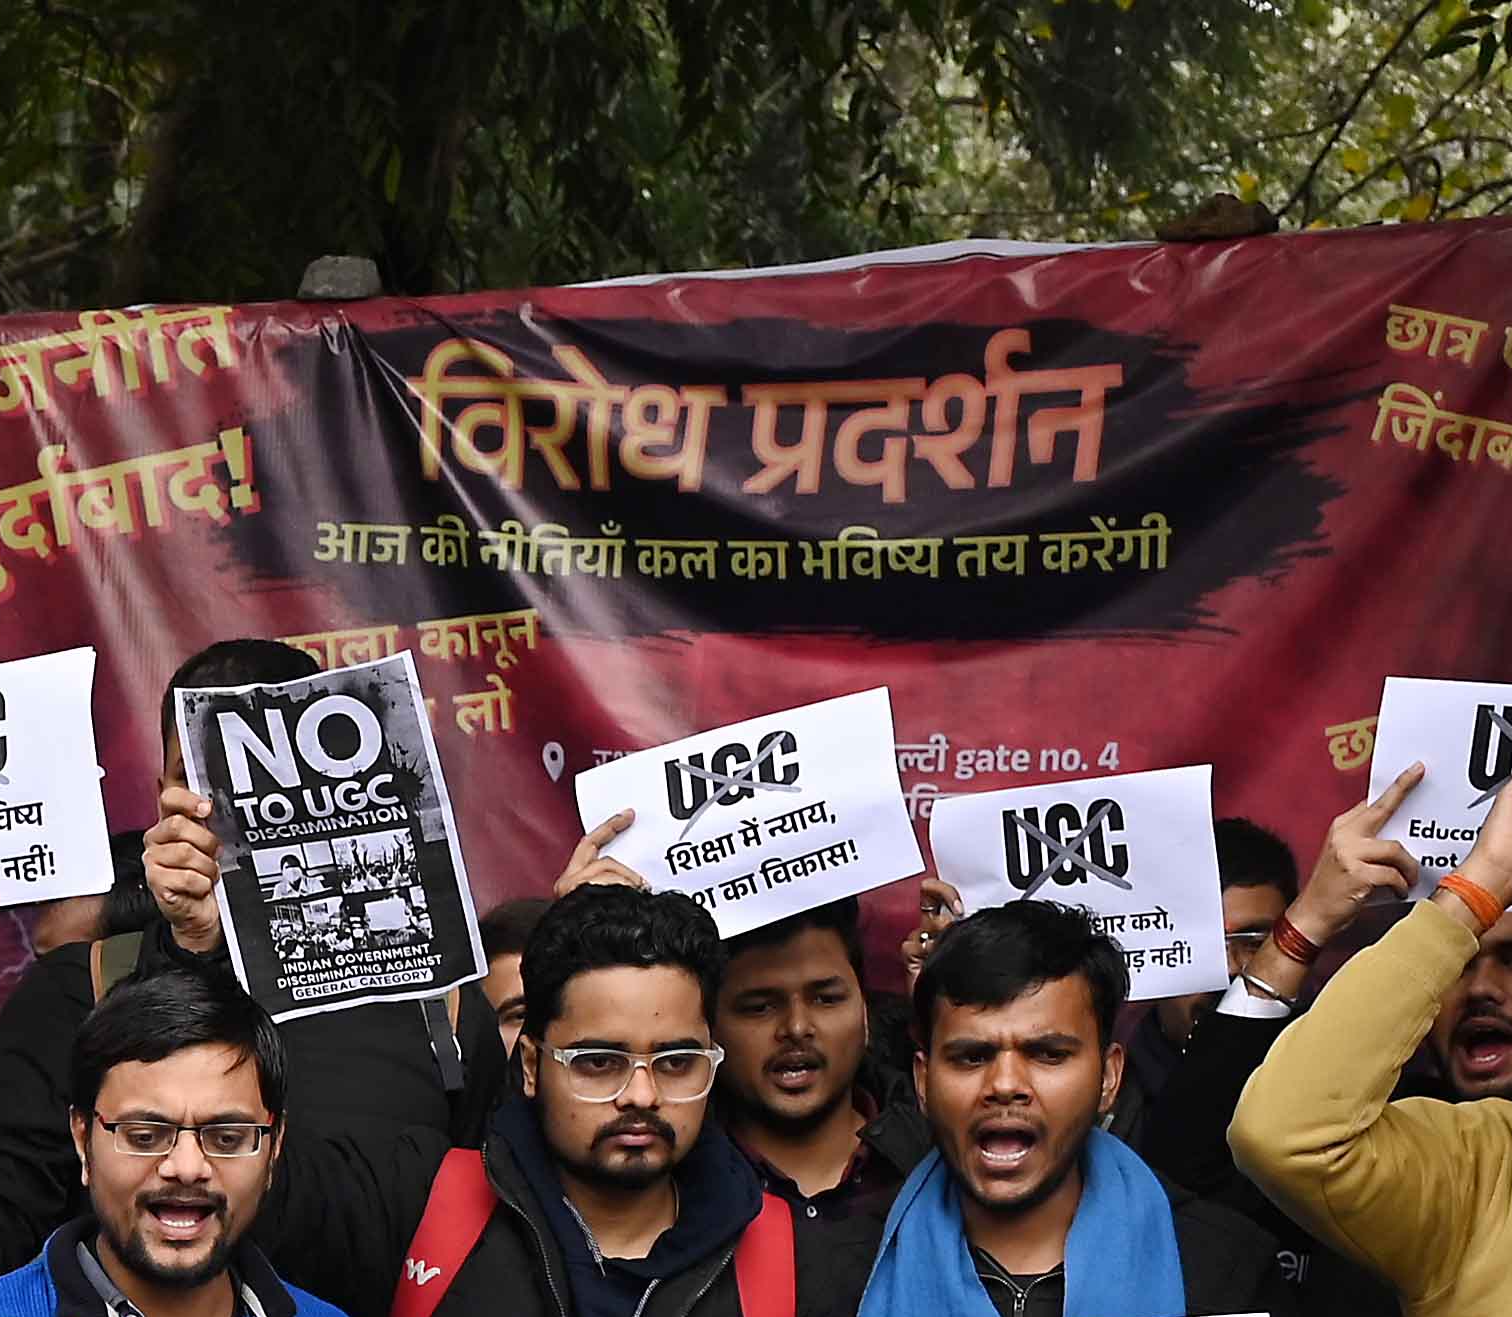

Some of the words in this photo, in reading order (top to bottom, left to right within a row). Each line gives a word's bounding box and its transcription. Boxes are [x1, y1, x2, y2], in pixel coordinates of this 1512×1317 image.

[1386, 304, 1488, 364] छात्र
[407, 338, 727, 494] विरोध
[742, 328, 1122, 504] प्रदर्शन
[313, 520, 412, 566] आज
[421, 514, 469, 569] की
[479, 518, 625, 577] नीतियाँ
[636, 537, 719, 581] कल
[727, 538, 788, 581] का
[799, 525, 942, 581] भविष्य
[955, 533, 1027, 577] तय
[1040, 512, 1172, 573] करेंगी
[417, 606, 540, 670] कानून
[216, 694, 382, 795] NO
[954, 744, 1030, 779] gate
[1039, 750, 1089, 772] no.
[1097, 741, 1120, 771] 4
[233, 791, 295, 829] TO
[302, 773, 400, 817] UGC
[664, 731, 800, 821] UGC
[245, 805, 408, 843] DISCRIMINATION
[665, 832, 736, 876] शिक्षा
[738, 816, 763, 850] में
[764, 800, 837, 839] न्याय,
[1002, 798, 1129, 891] UGC
[277, 963, 382, 989] DISCRIMINATING
[385, 954, 443, 975] AGAINST
[283, 955, 332, 976] INDIAN
[334, 943, 431, 967] GOVERNMENT
[294, 980, 356, 999] GENERAL
[359, 969, 430, 989] CATEGORY
